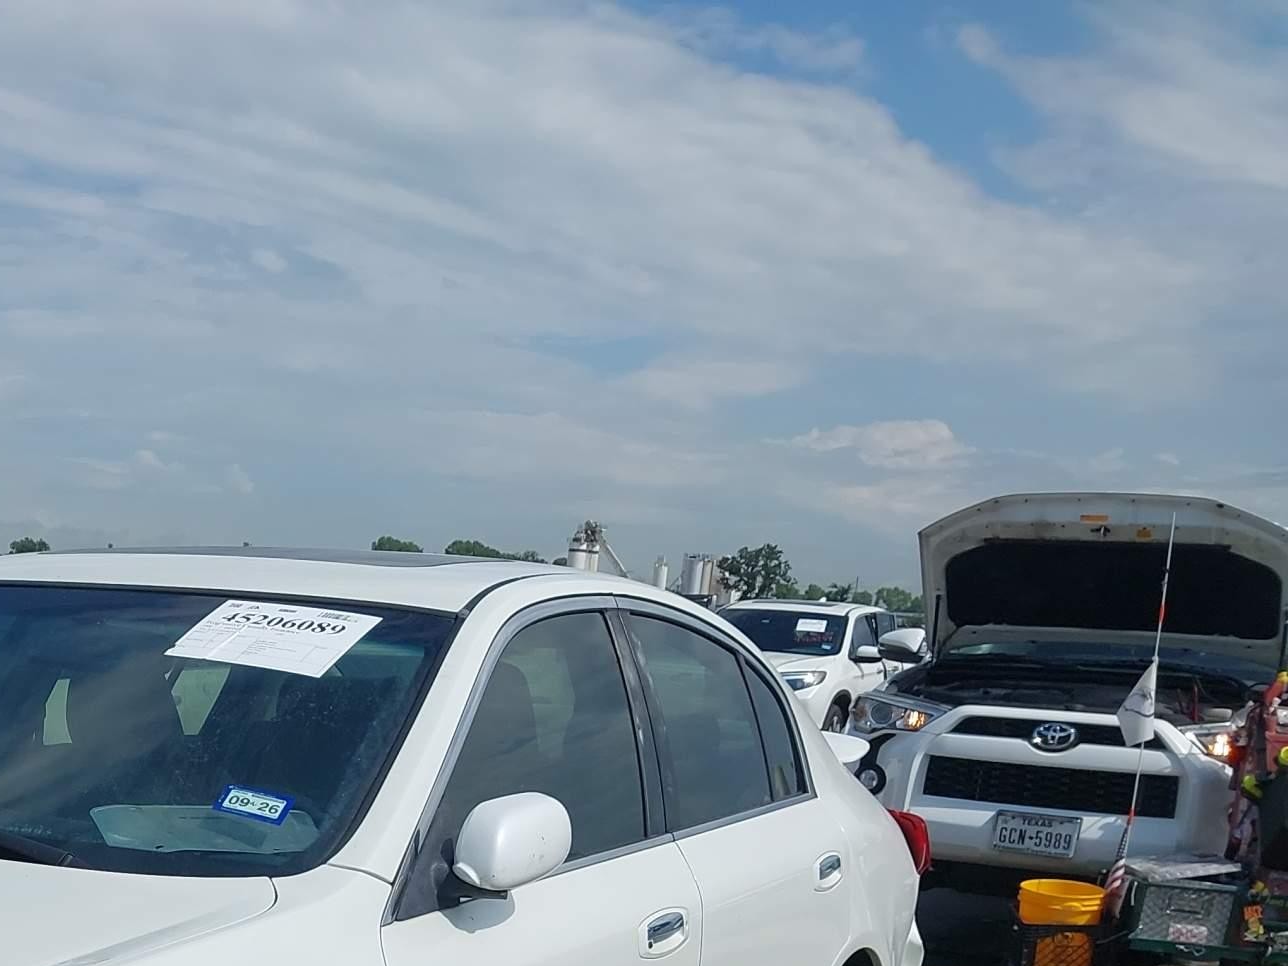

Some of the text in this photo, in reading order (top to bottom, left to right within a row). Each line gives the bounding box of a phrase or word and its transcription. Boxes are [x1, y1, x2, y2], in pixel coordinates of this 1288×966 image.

[221, 611, 347, 635] 45206089
[228, 795, 251, 807] 09
[256, 801, 281, 815] 26
[1022, 818, 1053, 827] TEXAS
